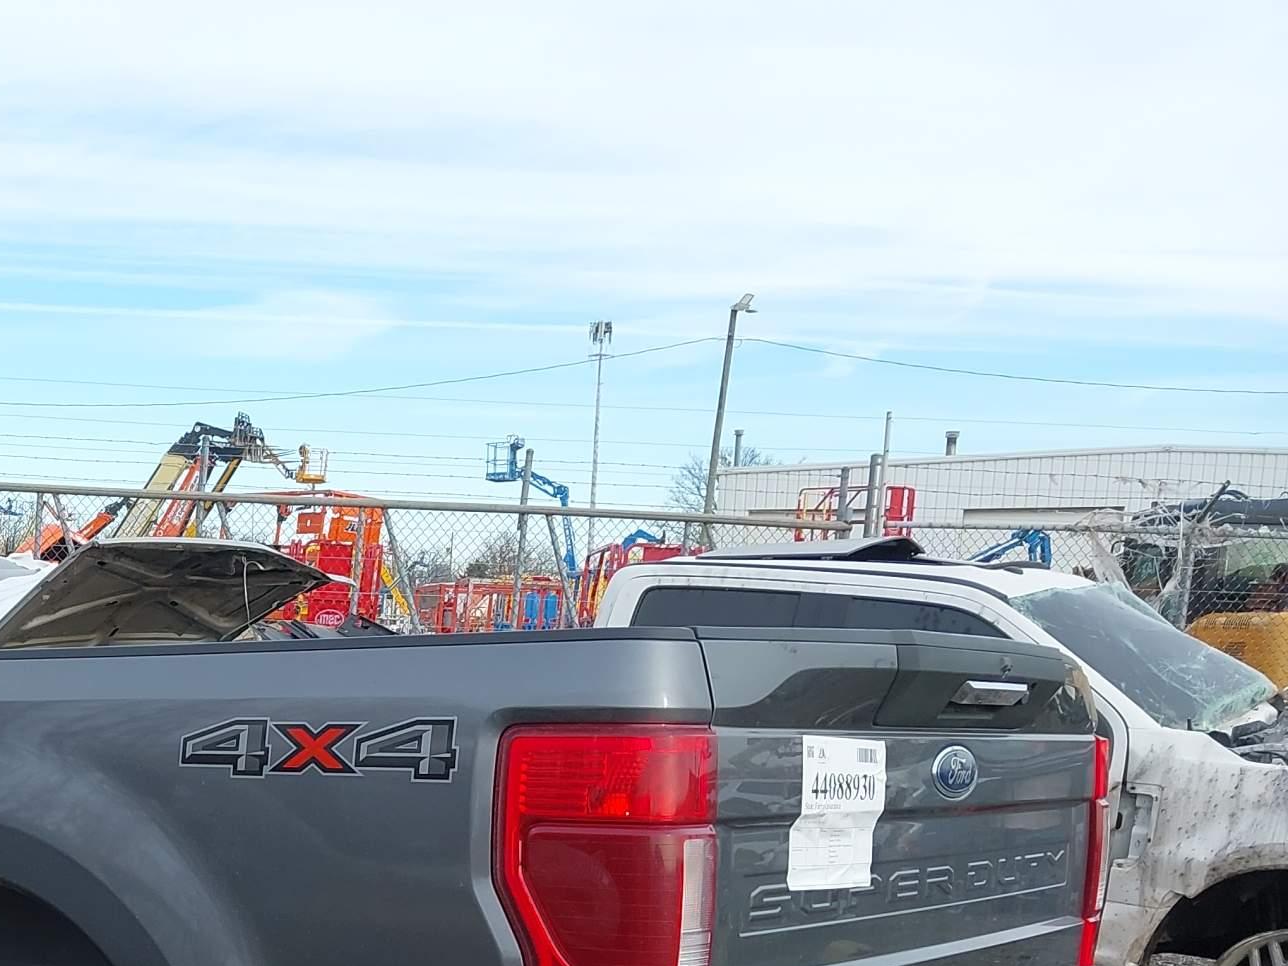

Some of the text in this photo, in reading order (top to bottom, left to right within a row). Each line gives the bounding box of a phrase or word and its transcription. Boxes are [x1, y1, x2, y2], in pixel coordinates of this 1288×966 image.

[811, 771, 875, 801] 44088930
[948, 757, 972, 785] Ford
[966, 849, 1065, 888] DUTY
